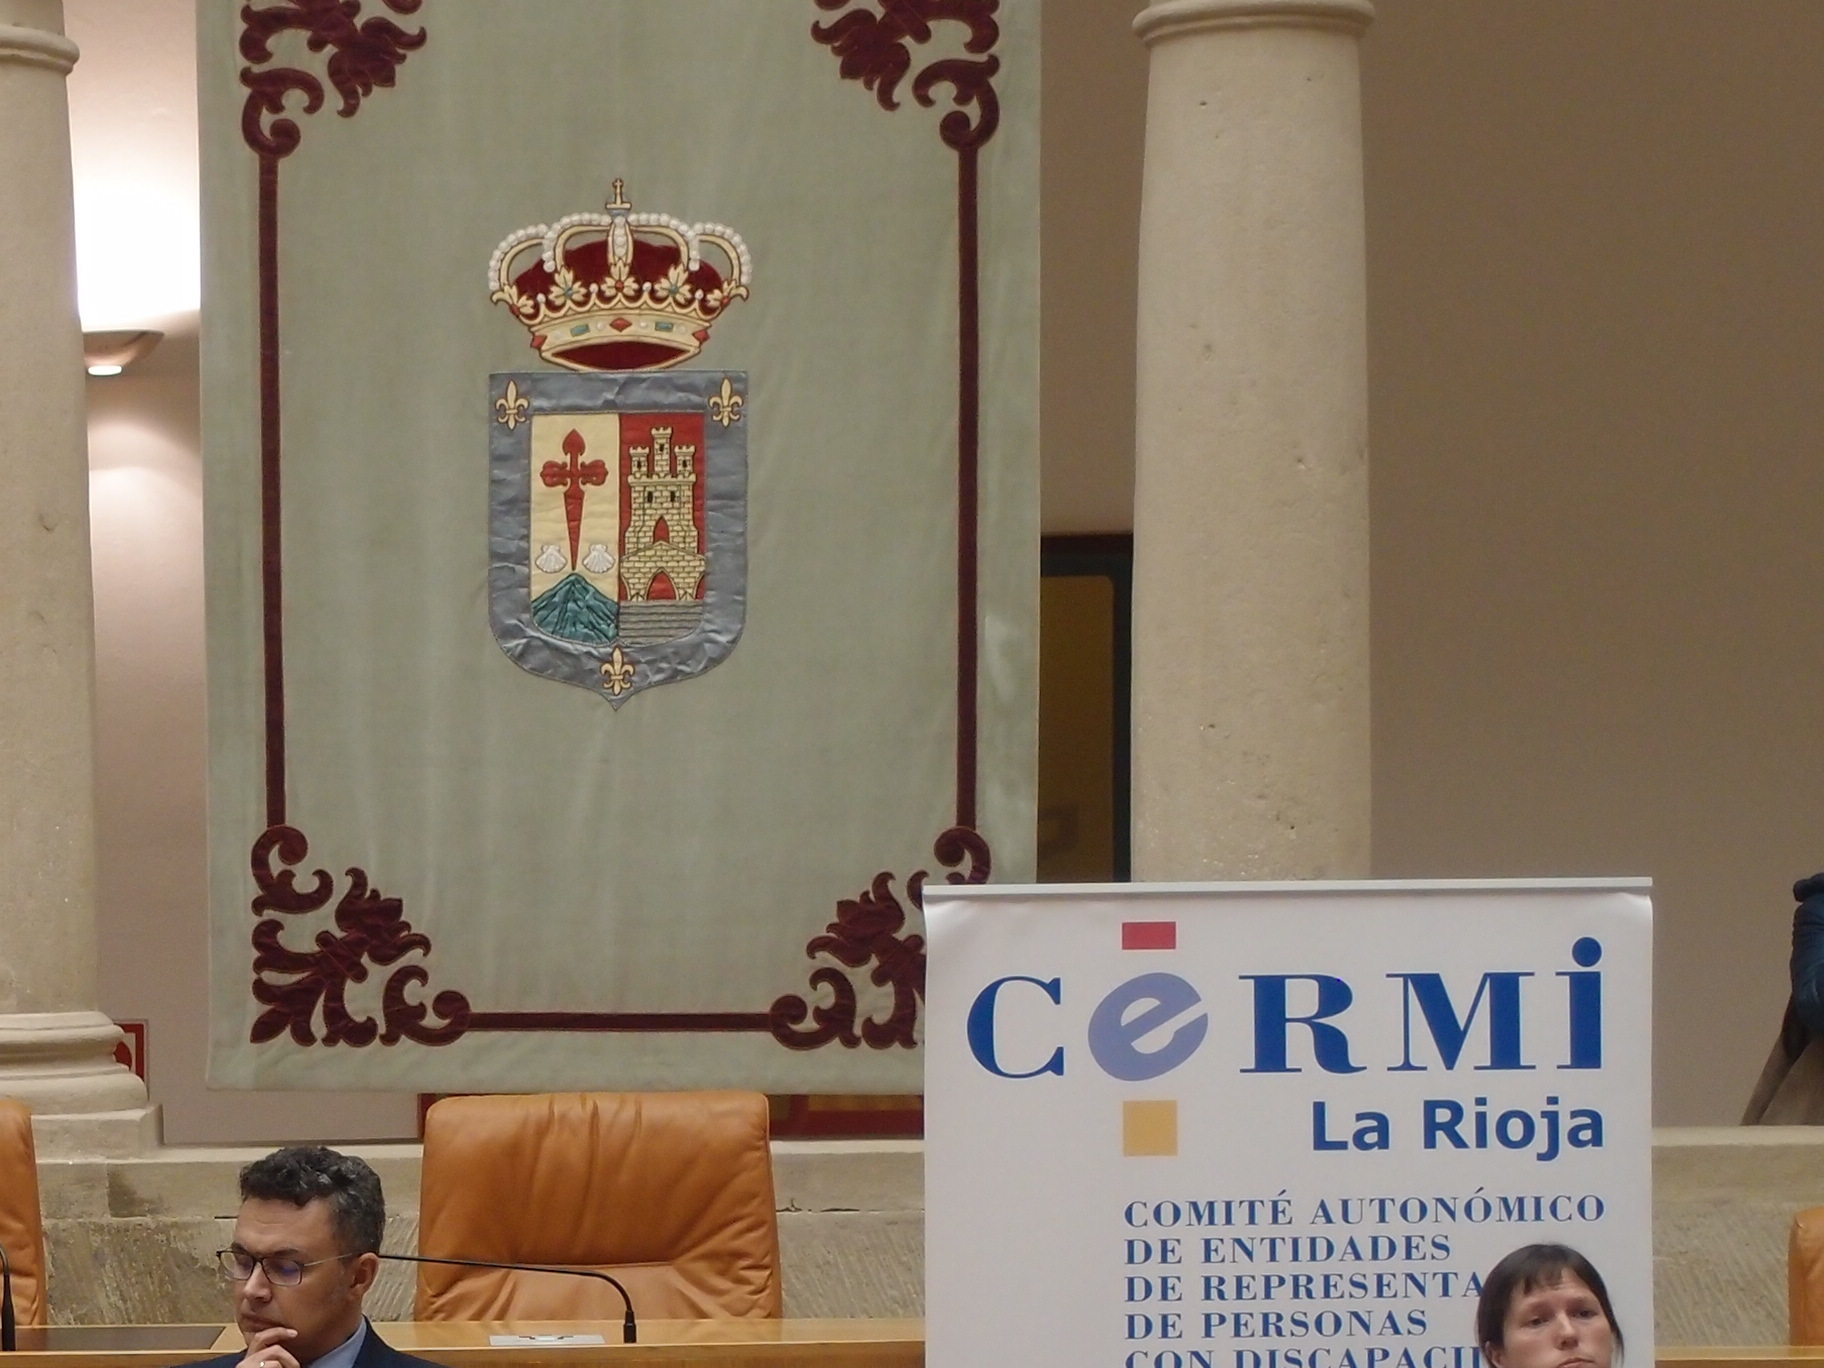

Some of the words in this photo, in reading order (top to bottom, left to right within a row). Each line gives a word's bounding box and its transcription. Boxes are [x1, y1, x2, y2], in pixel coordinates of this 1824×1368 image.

[1312, 1100, 1391, 1152] La
[1423, 1095, 1604, 1163] Rioja
[1124, 1189, 1294, 1228] COMITÉ
[1309, 1186, 1605, 1226] AUTONÓMICO
[1125, 1237, 1183, 1266] DE
[1200, 1233, 1452, 1264] ENTIDADES
[1125, 1274, 1183, 1303] DE
[1125, 1312, 1183, 1341] DE
[1201, 1308, 1428, 1339] PERSONAS
